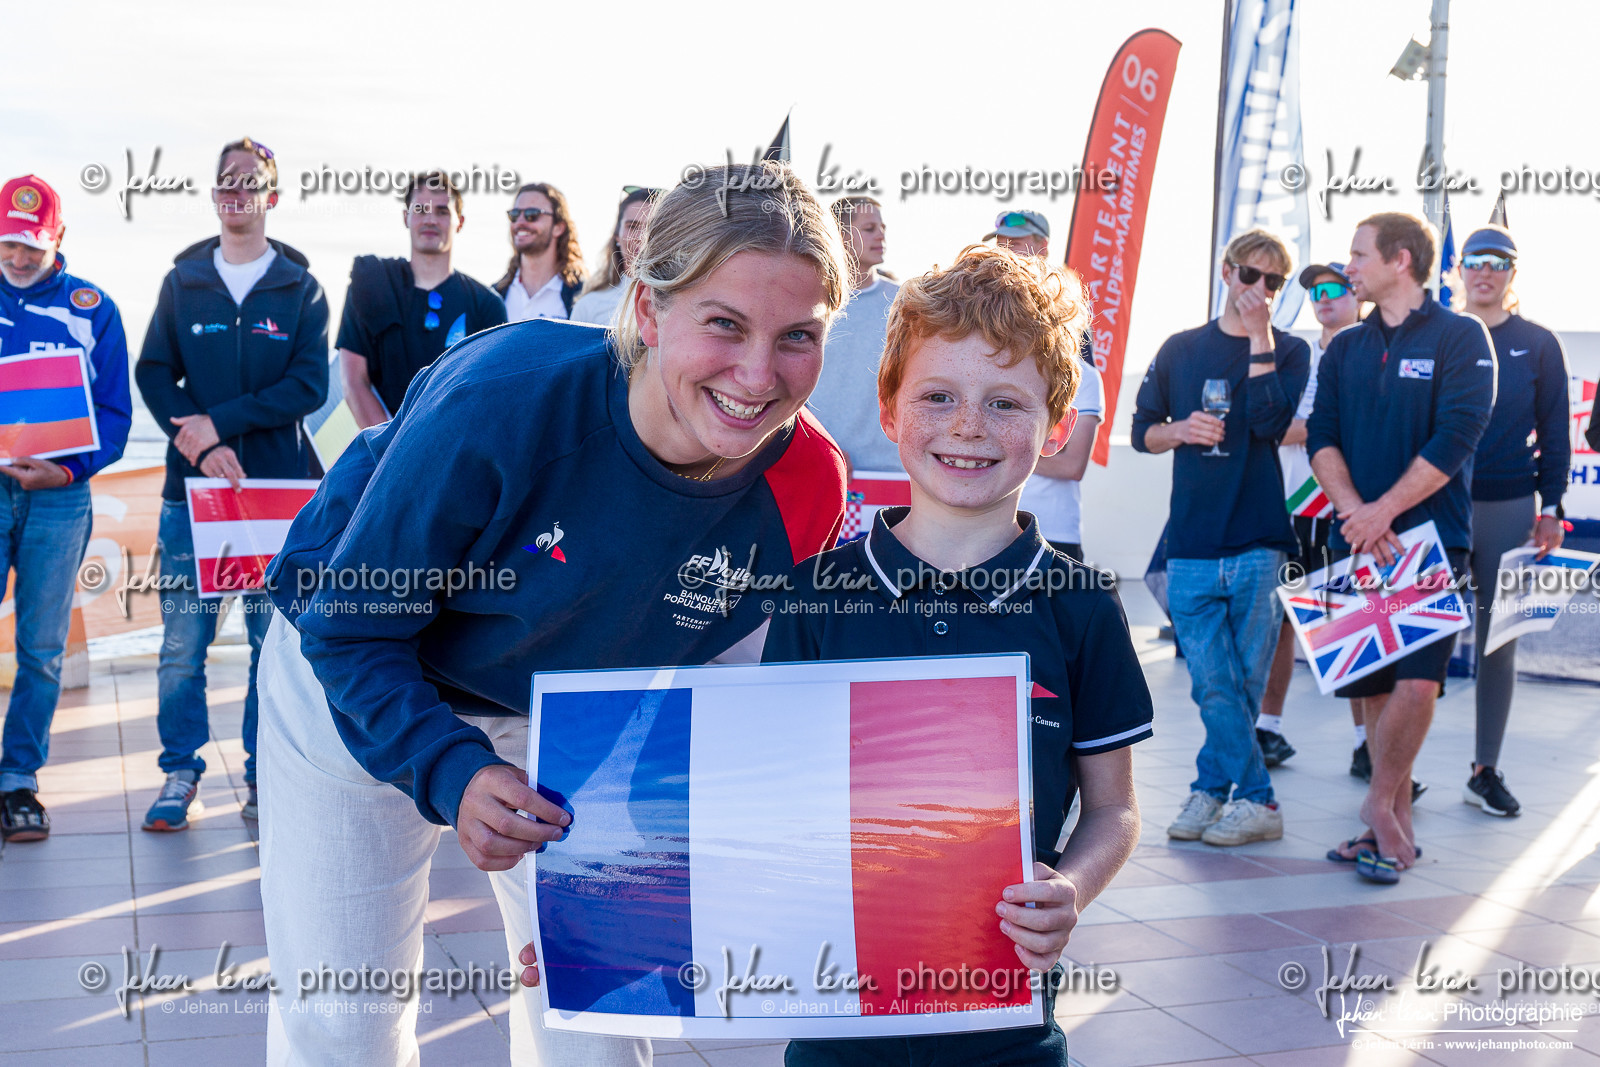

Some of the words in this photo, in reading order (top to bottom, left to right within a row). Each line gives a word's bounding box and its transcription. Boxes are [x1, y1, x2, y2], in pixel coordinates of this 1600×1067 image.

[1122, 53, 1159, 102] 06
[1102, 123, 1148, 326] ALPES-MARITIMES
[1094, 329, 1114, 373] DES
[663, 593, 718, 614] POPULAIRE
[679, 589, 720, 607] BANQUE
[1035, 715, 1060, 729] Cannes
